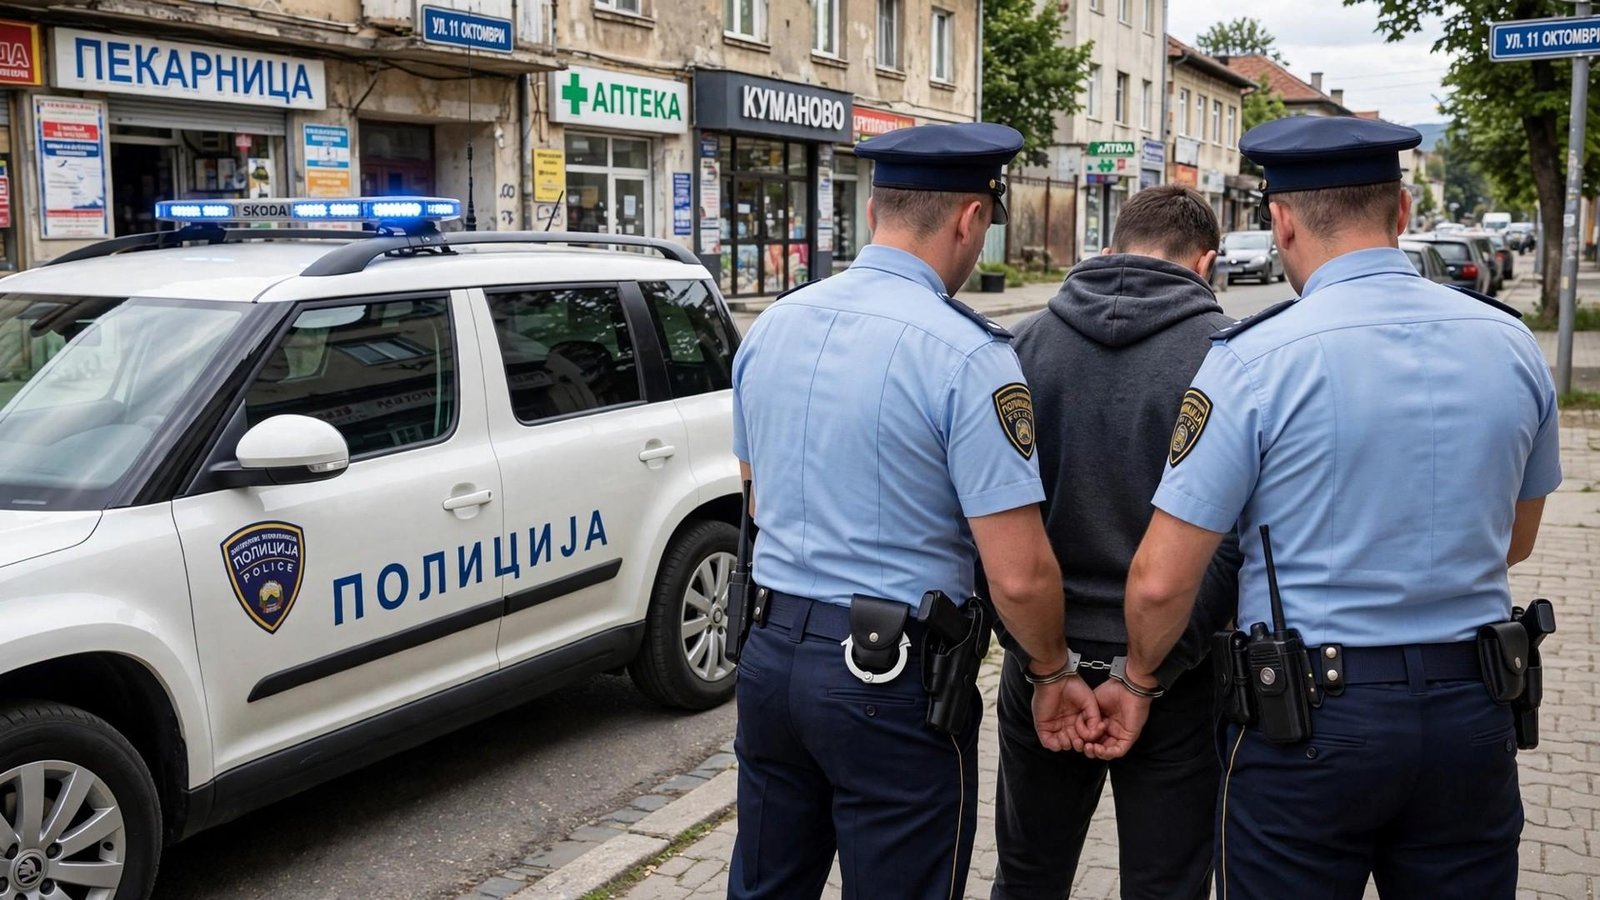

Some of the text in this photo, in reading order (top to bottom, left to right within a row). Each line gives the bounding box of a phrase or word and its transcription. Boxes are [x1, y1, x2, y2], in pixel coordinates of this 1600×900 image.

[432, 16, 505, 44] УЛ. 11 ОКТОМВРИ
[1505, 33, 1524, 49] УЛ.
[1527, 31, 1538, 47] 11
[75, 37, 313, 104] ПЕКАРНИЦА
[592, 82, 682, 121] АПТЕКА
[743, 85, 845, 130] КУМАНОВО
[243, 205, 287, 217] SKODA
[233, 541, 298, 570] ПОЛИЦИЈА
[333, 509, 608, 626] ПОЛИЦИЈА
[243, 561, 294, 583] POLICE
